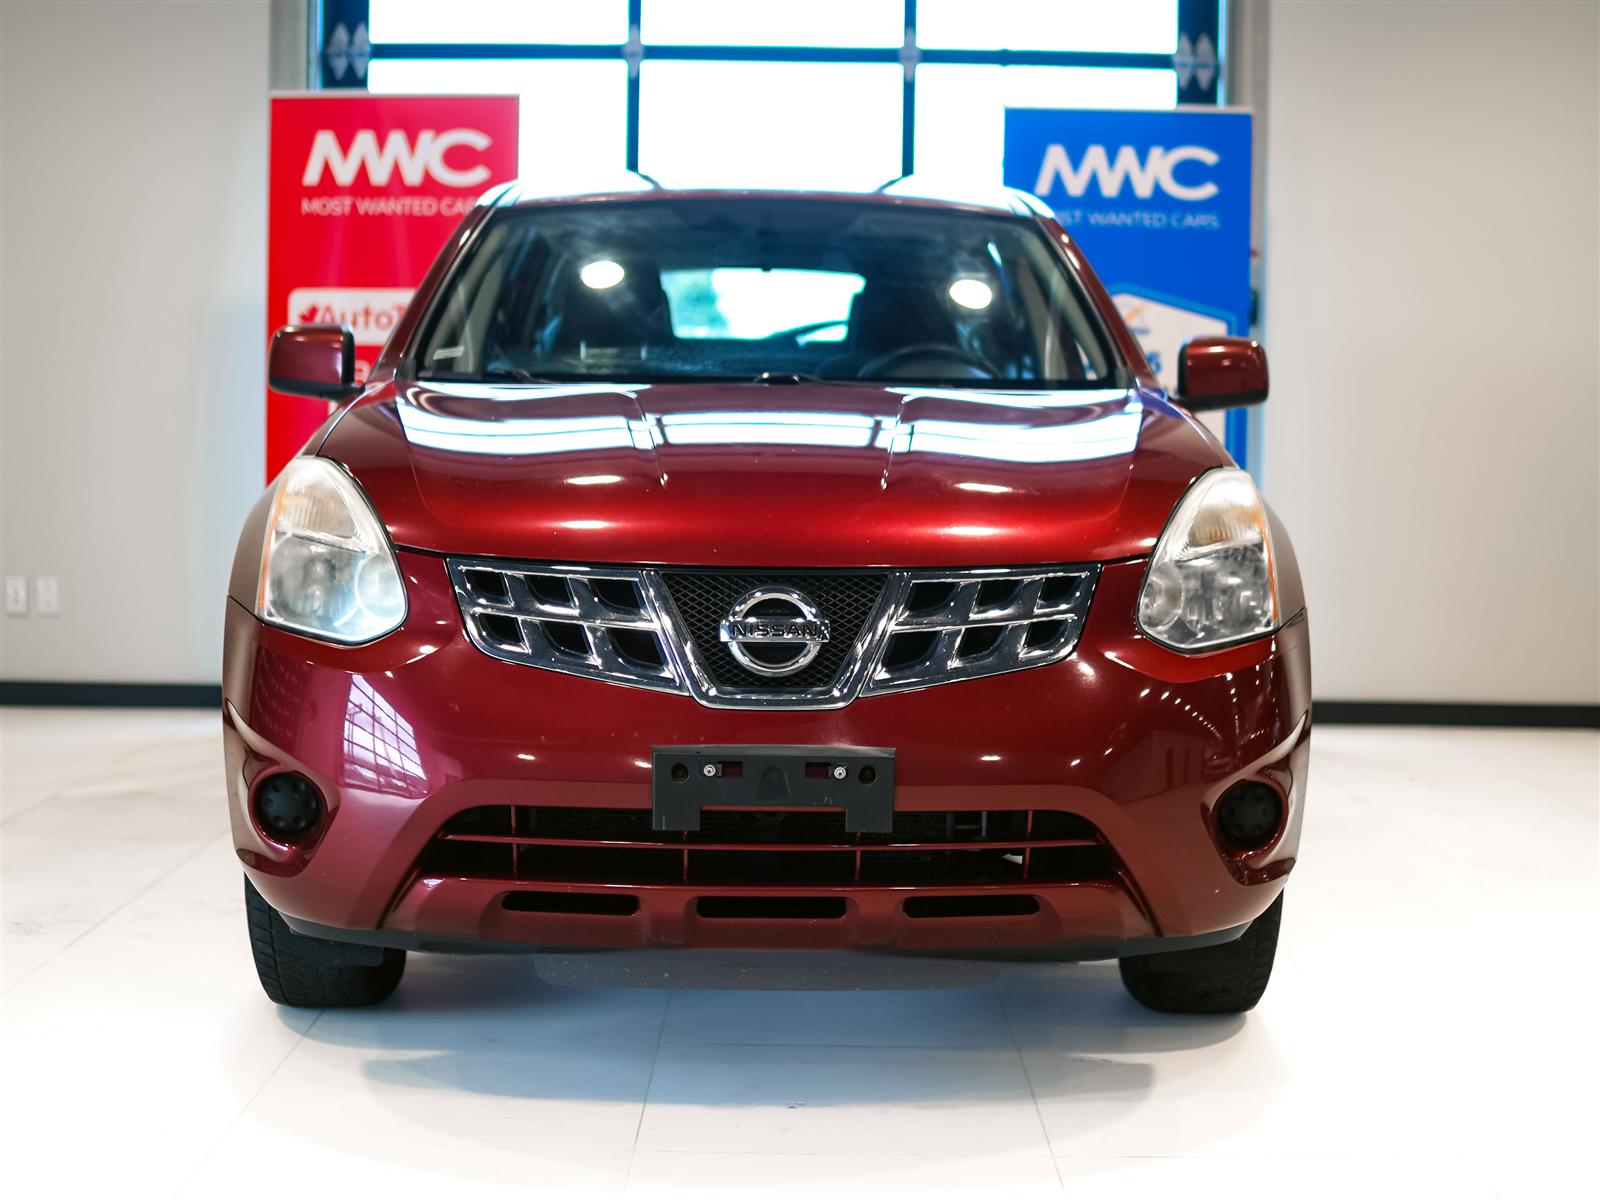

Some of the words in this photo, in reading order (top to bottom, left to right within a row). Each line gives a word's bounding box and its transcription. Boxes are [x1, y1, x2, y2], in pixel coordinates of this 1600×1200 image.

[302, 128, 492, 187] MWC
[1034, 144, 1220, 201] MWC
[301, 197, 351, 216] MOST
[356, 197, 437, 216] WANTED
[439, 197, 476, 215] CAR
[1087, 209, 1166, 228] WANTED
[1169, 211, 1220, 229] CARS
[733, 623, 818, 637] NISSAN
